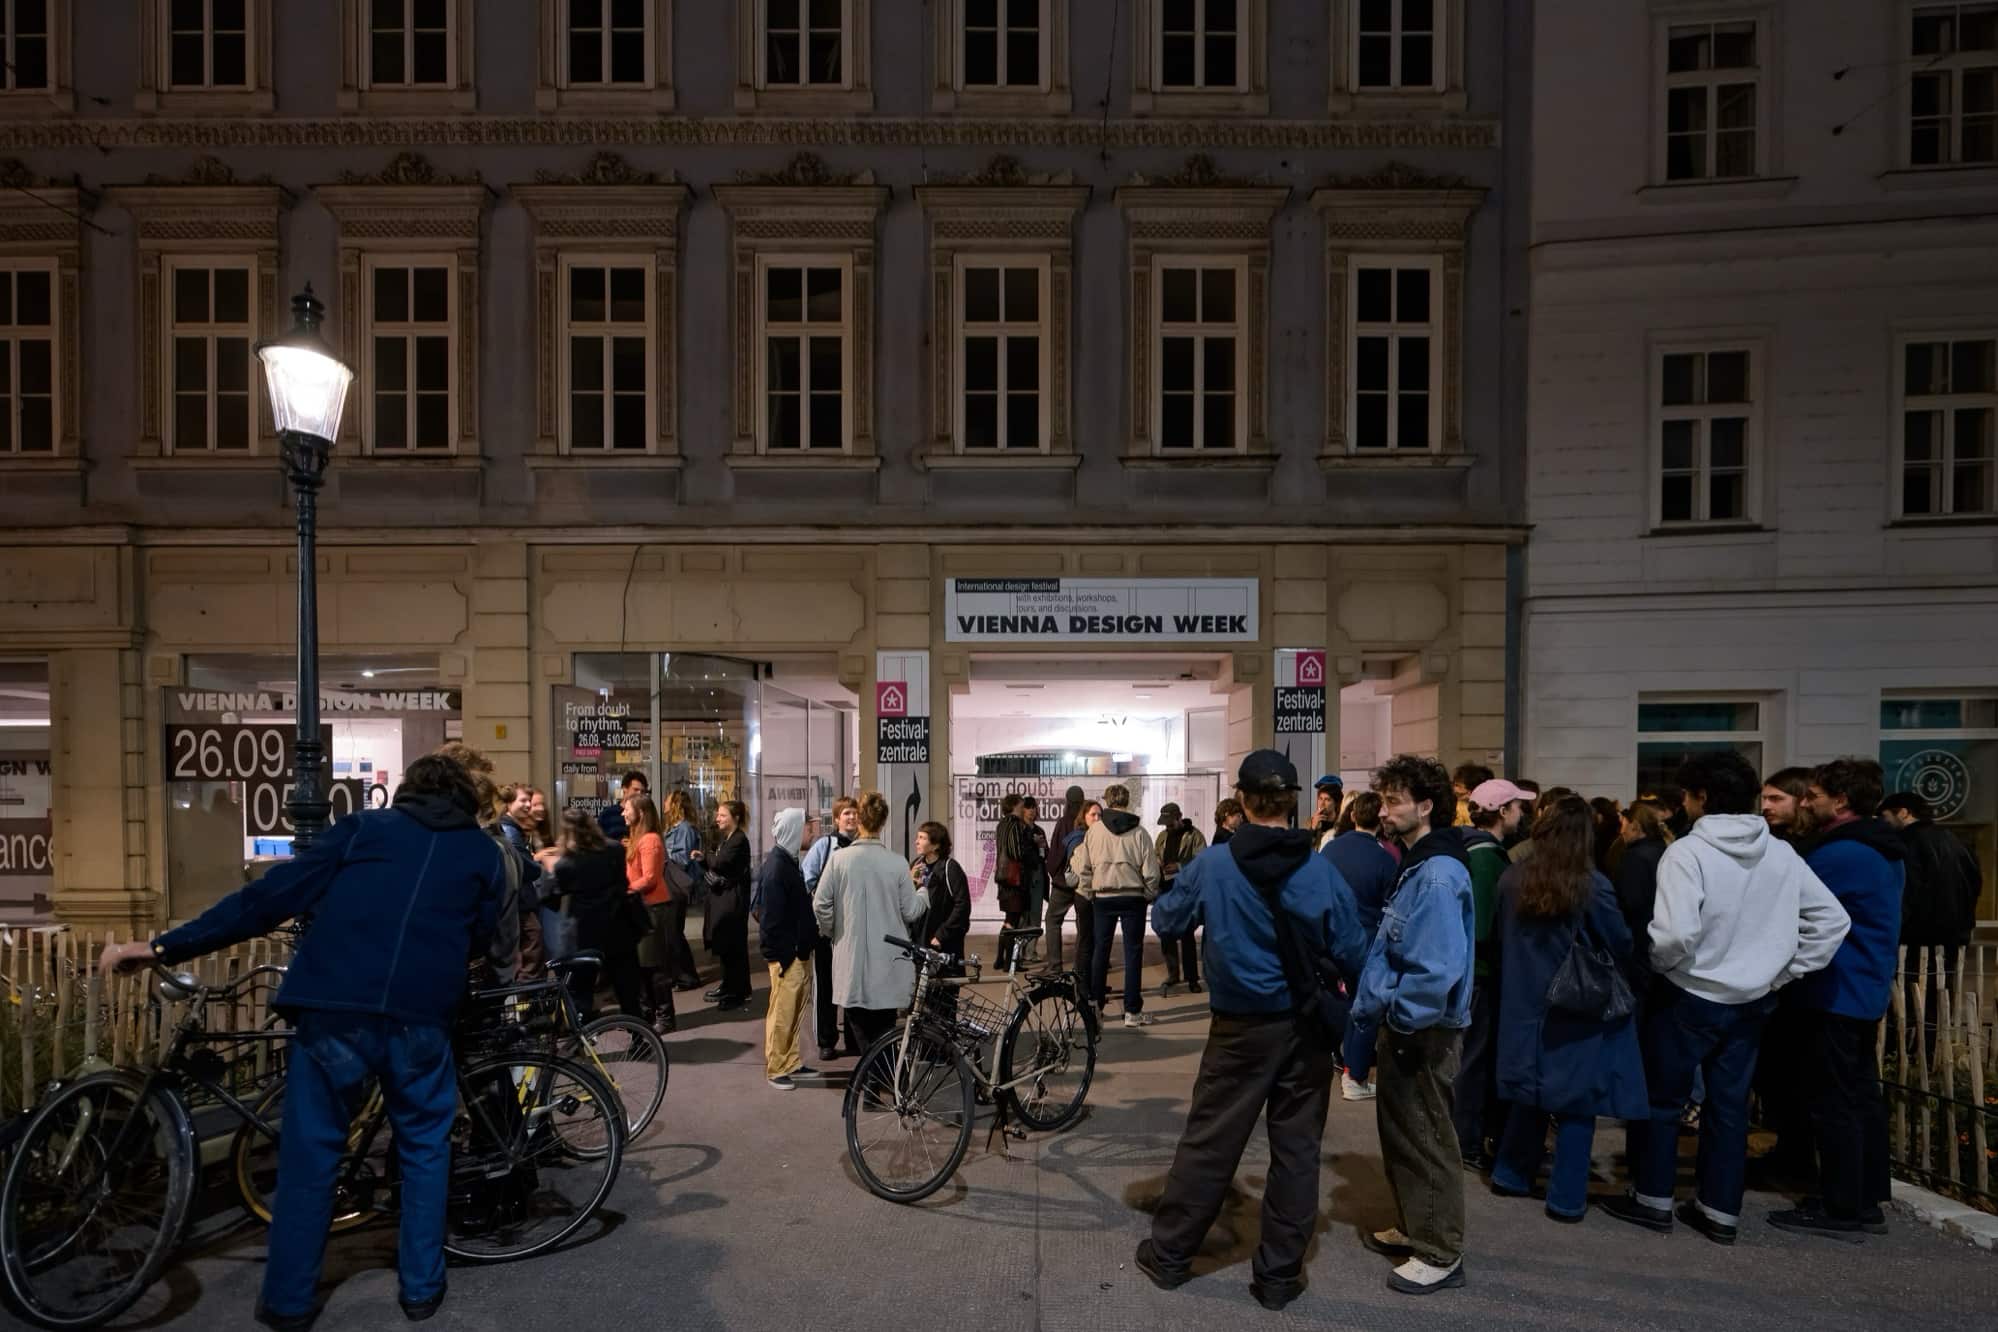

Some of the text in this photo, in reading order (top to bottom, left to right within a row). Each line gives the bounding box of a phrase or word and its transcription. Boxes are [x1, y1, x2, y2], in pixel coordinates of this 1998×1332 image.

[957, 580, 1058, 593] International design festival
[1016, 593, 1032, 602] with
[1038, 604, 1053, 612] and
[957, 615, 1247, 633] VIENNA DESIGN WEEK
[177, 692, 274, 711] VIENNA
[380, 692, 450, 711] WEEK
[1277, 688, 1325, 709] Festival-
[566, 701, 630, 717] From doubt
[566, 717, 623, 733] to rhythm.
[880, 718, 929, 740] Festival-
[1276, 711, 1323, 732] zentrale
[578, 733, 601, 747] 26.09.
[174, 729, 293, 778] 26.09.
[880, 741, 928, 762] zentrale
[563, 764, 597, 775] daily from
[959, 777, 1054, 797] From doubt
[570, 798, 600, 809] Spotlight
[959, 801, 974, 819] to
